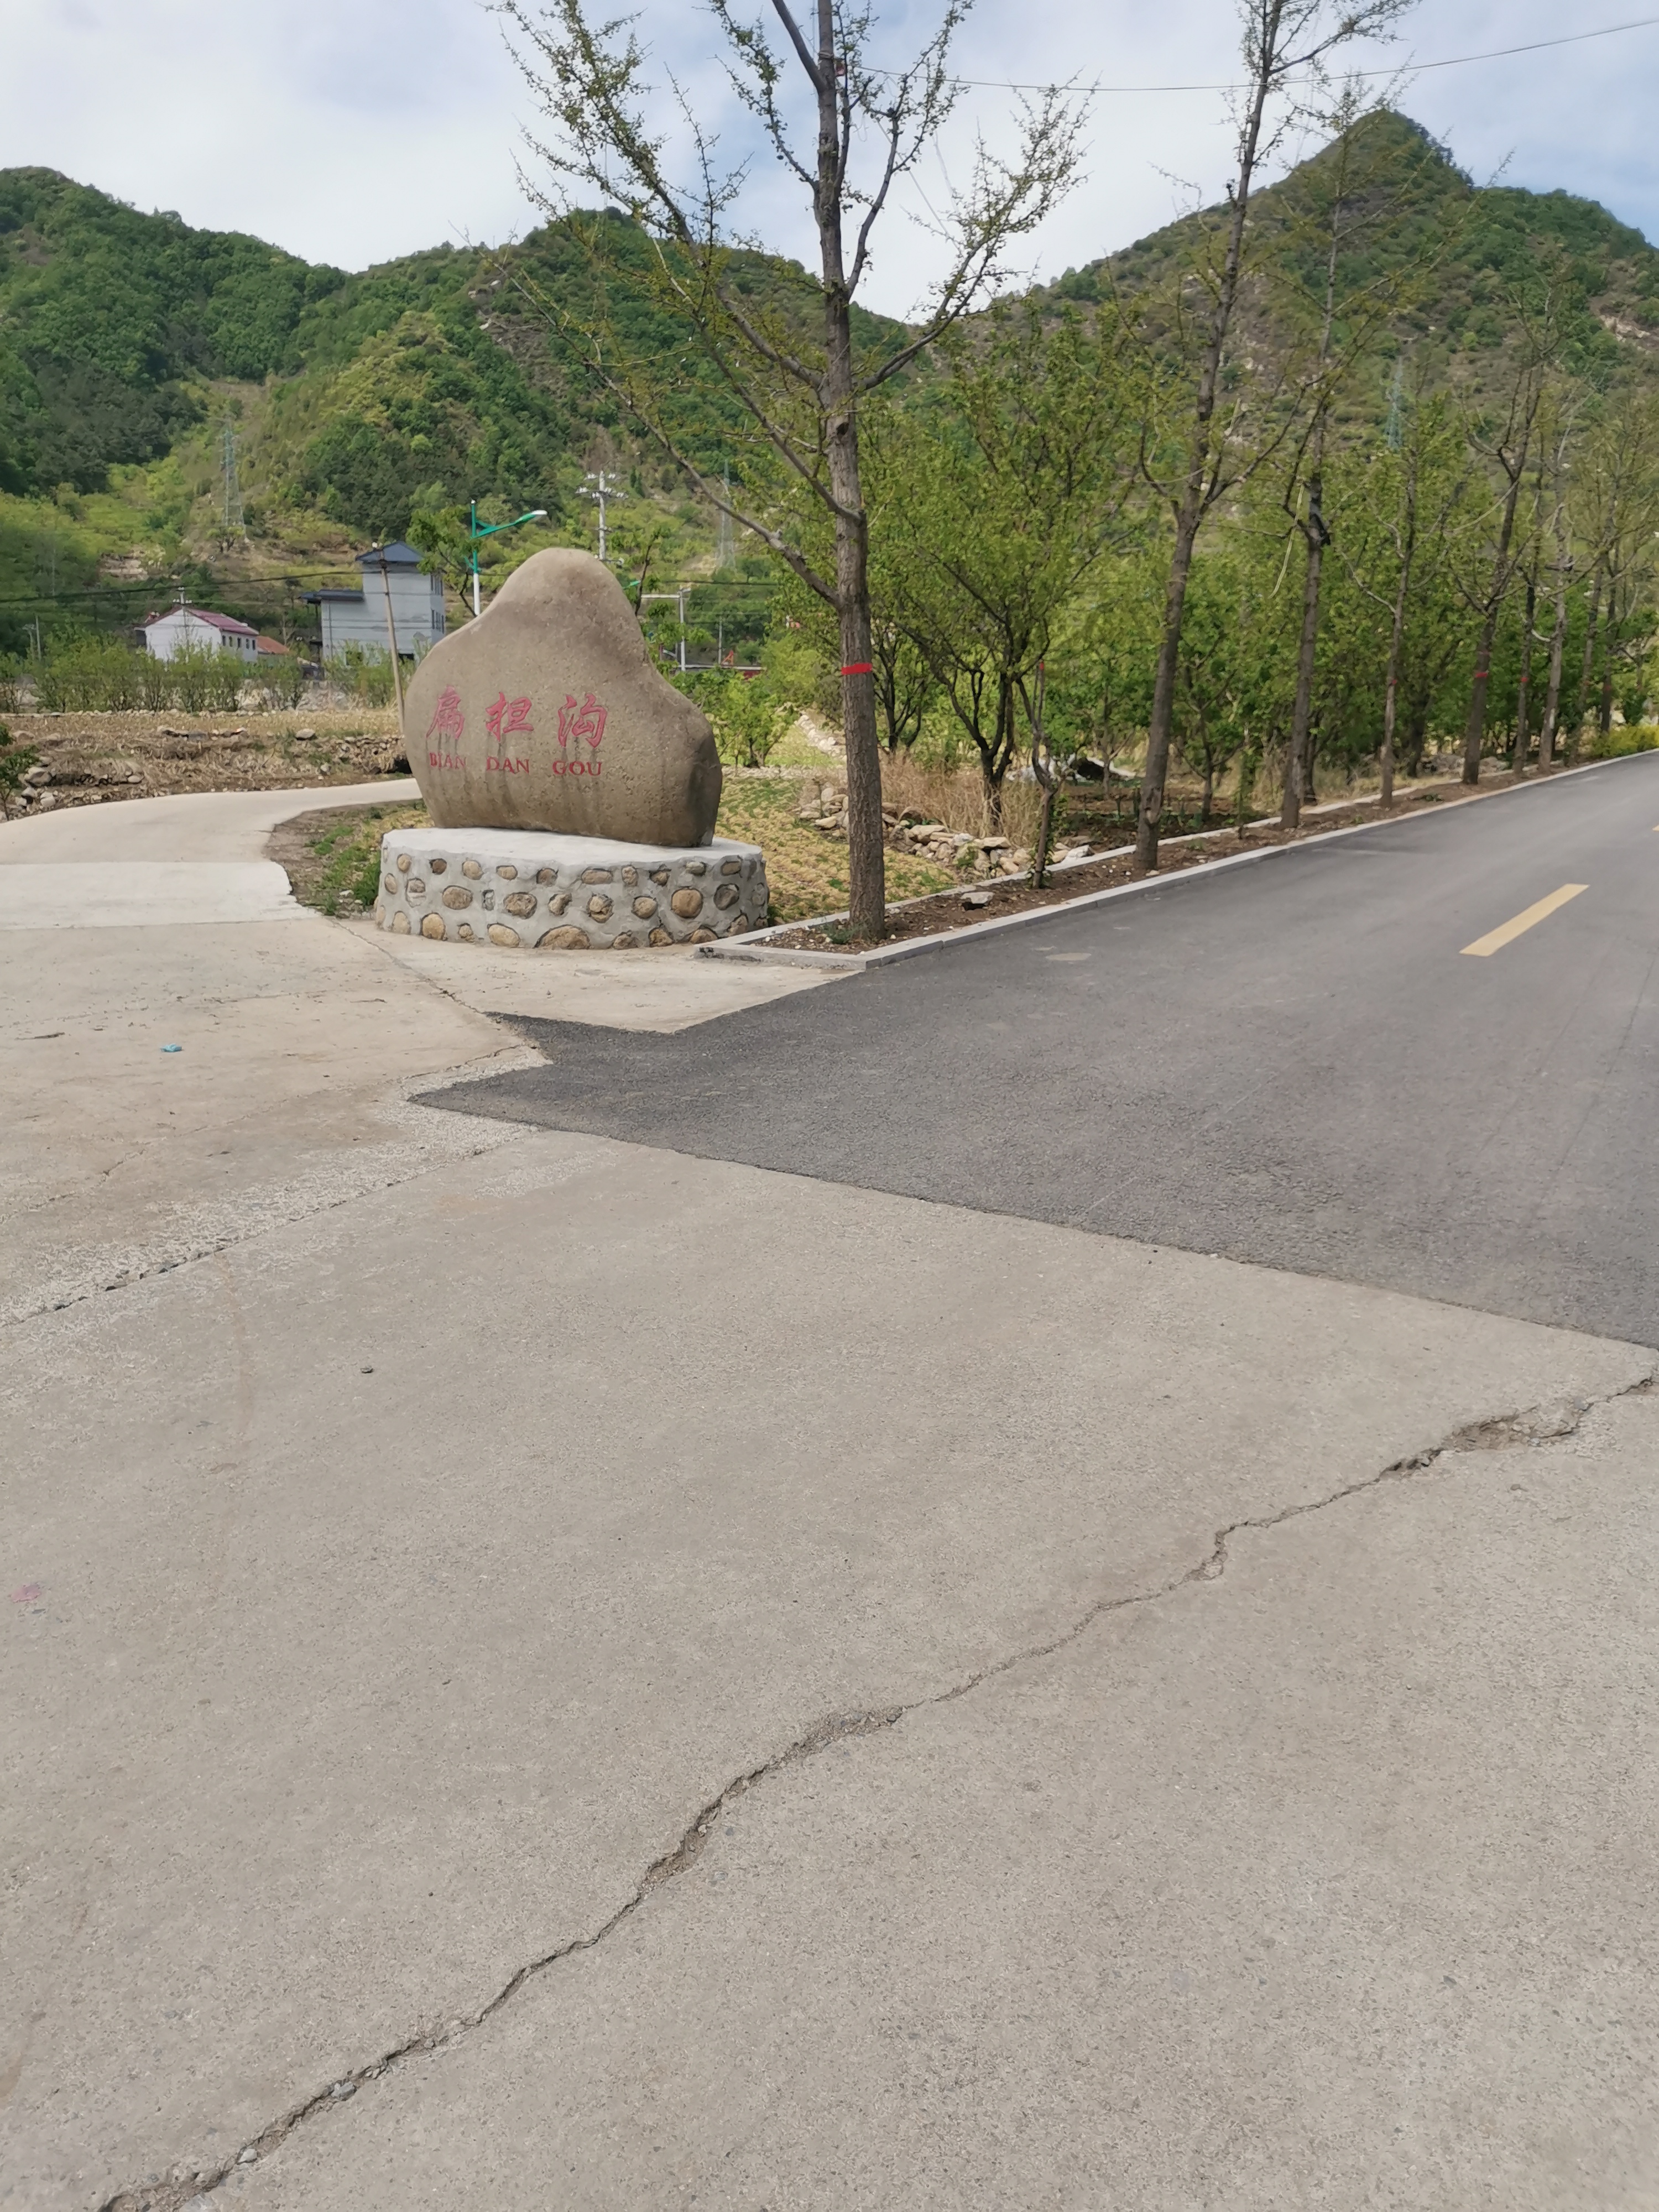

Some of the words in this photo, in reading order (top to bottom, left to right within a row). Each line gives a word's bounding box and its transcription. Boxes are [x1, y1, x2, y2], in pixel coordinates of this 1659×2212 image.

[426, 685, 608, 749] 扁担沟
[429, 752, 467, 770] BIAN
[486, 756, 530, 775] DAN
[552, 760, 603, 777] GOU
